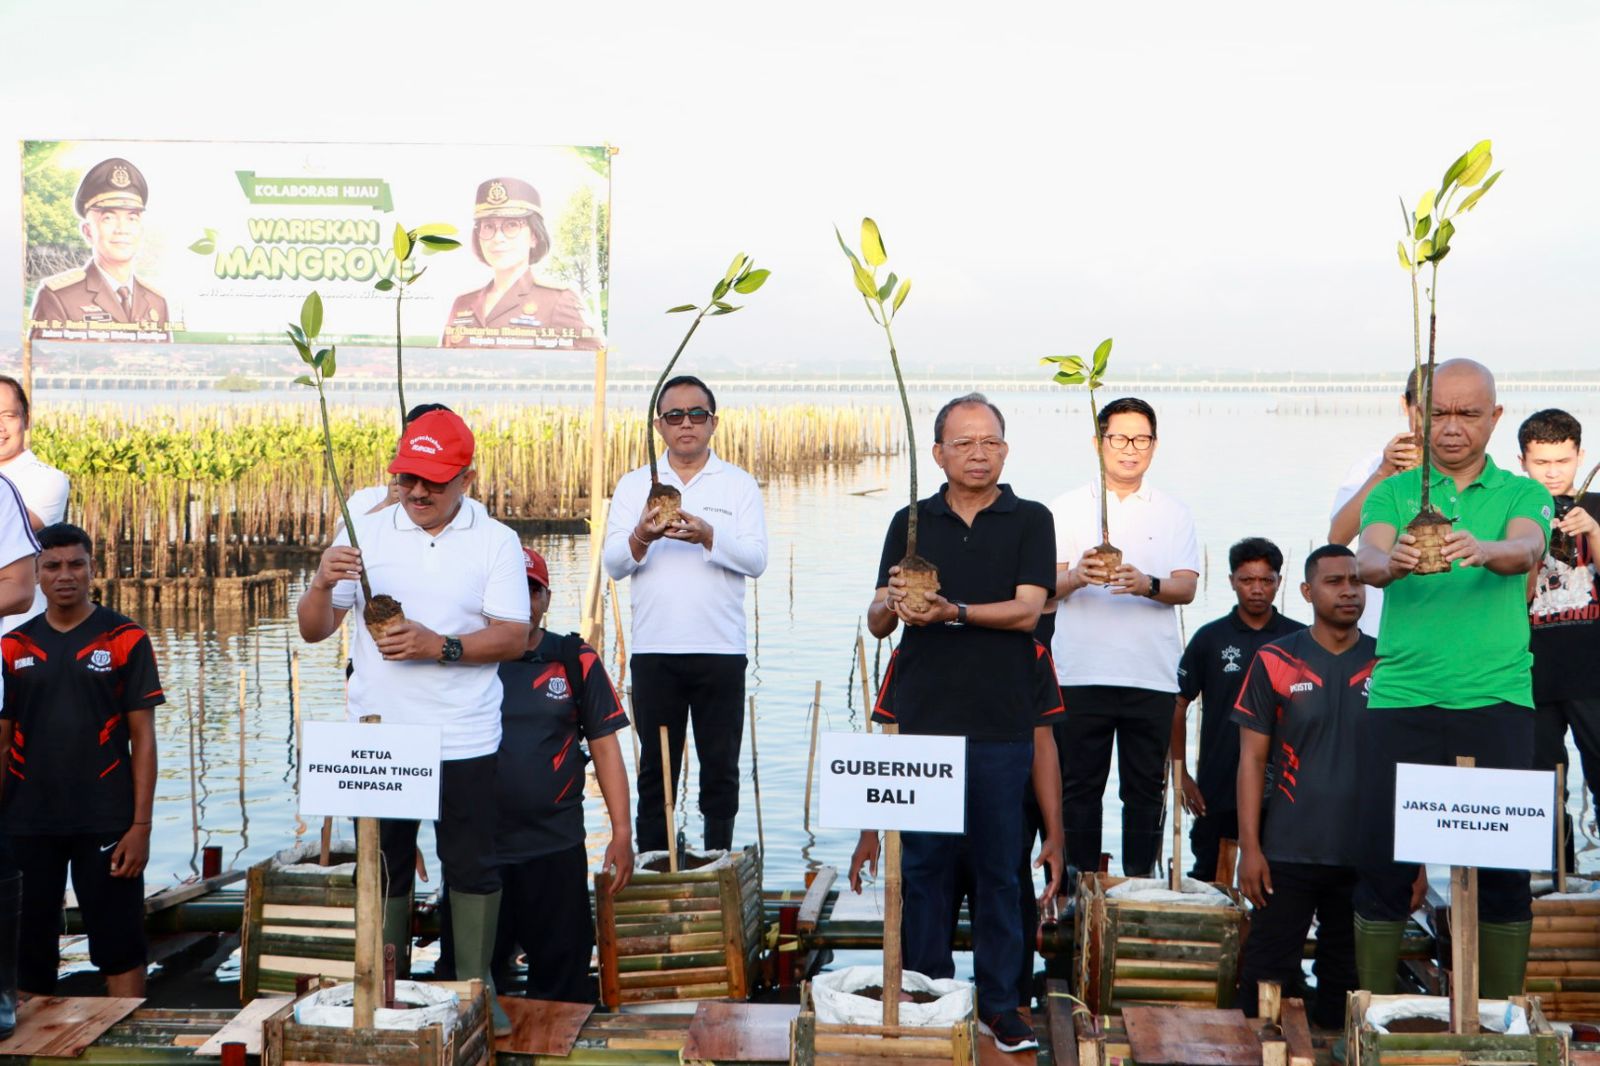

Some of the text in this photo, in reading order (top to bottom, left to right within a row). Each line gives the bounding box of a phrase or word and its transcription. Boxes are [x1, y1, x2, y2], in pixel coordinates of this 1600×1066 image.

[255, 185, 338, 198] KOLABORASI
[248, 218, 380, 245] WARISKAN
[351, 750, 392, 760] KETUA
[308, 764, 433, 777] PENGADILAN TINGGI
[830, 759, 953, 779] GUBERNUR
[338, 780, 403, 791] DENPASAR
[866, 788, 915, 805] BALI
[1402, 800, 1546, 818] JAKSA AGUNG MUDA
[1437, 818, 1509, 832] INTELIJEN
